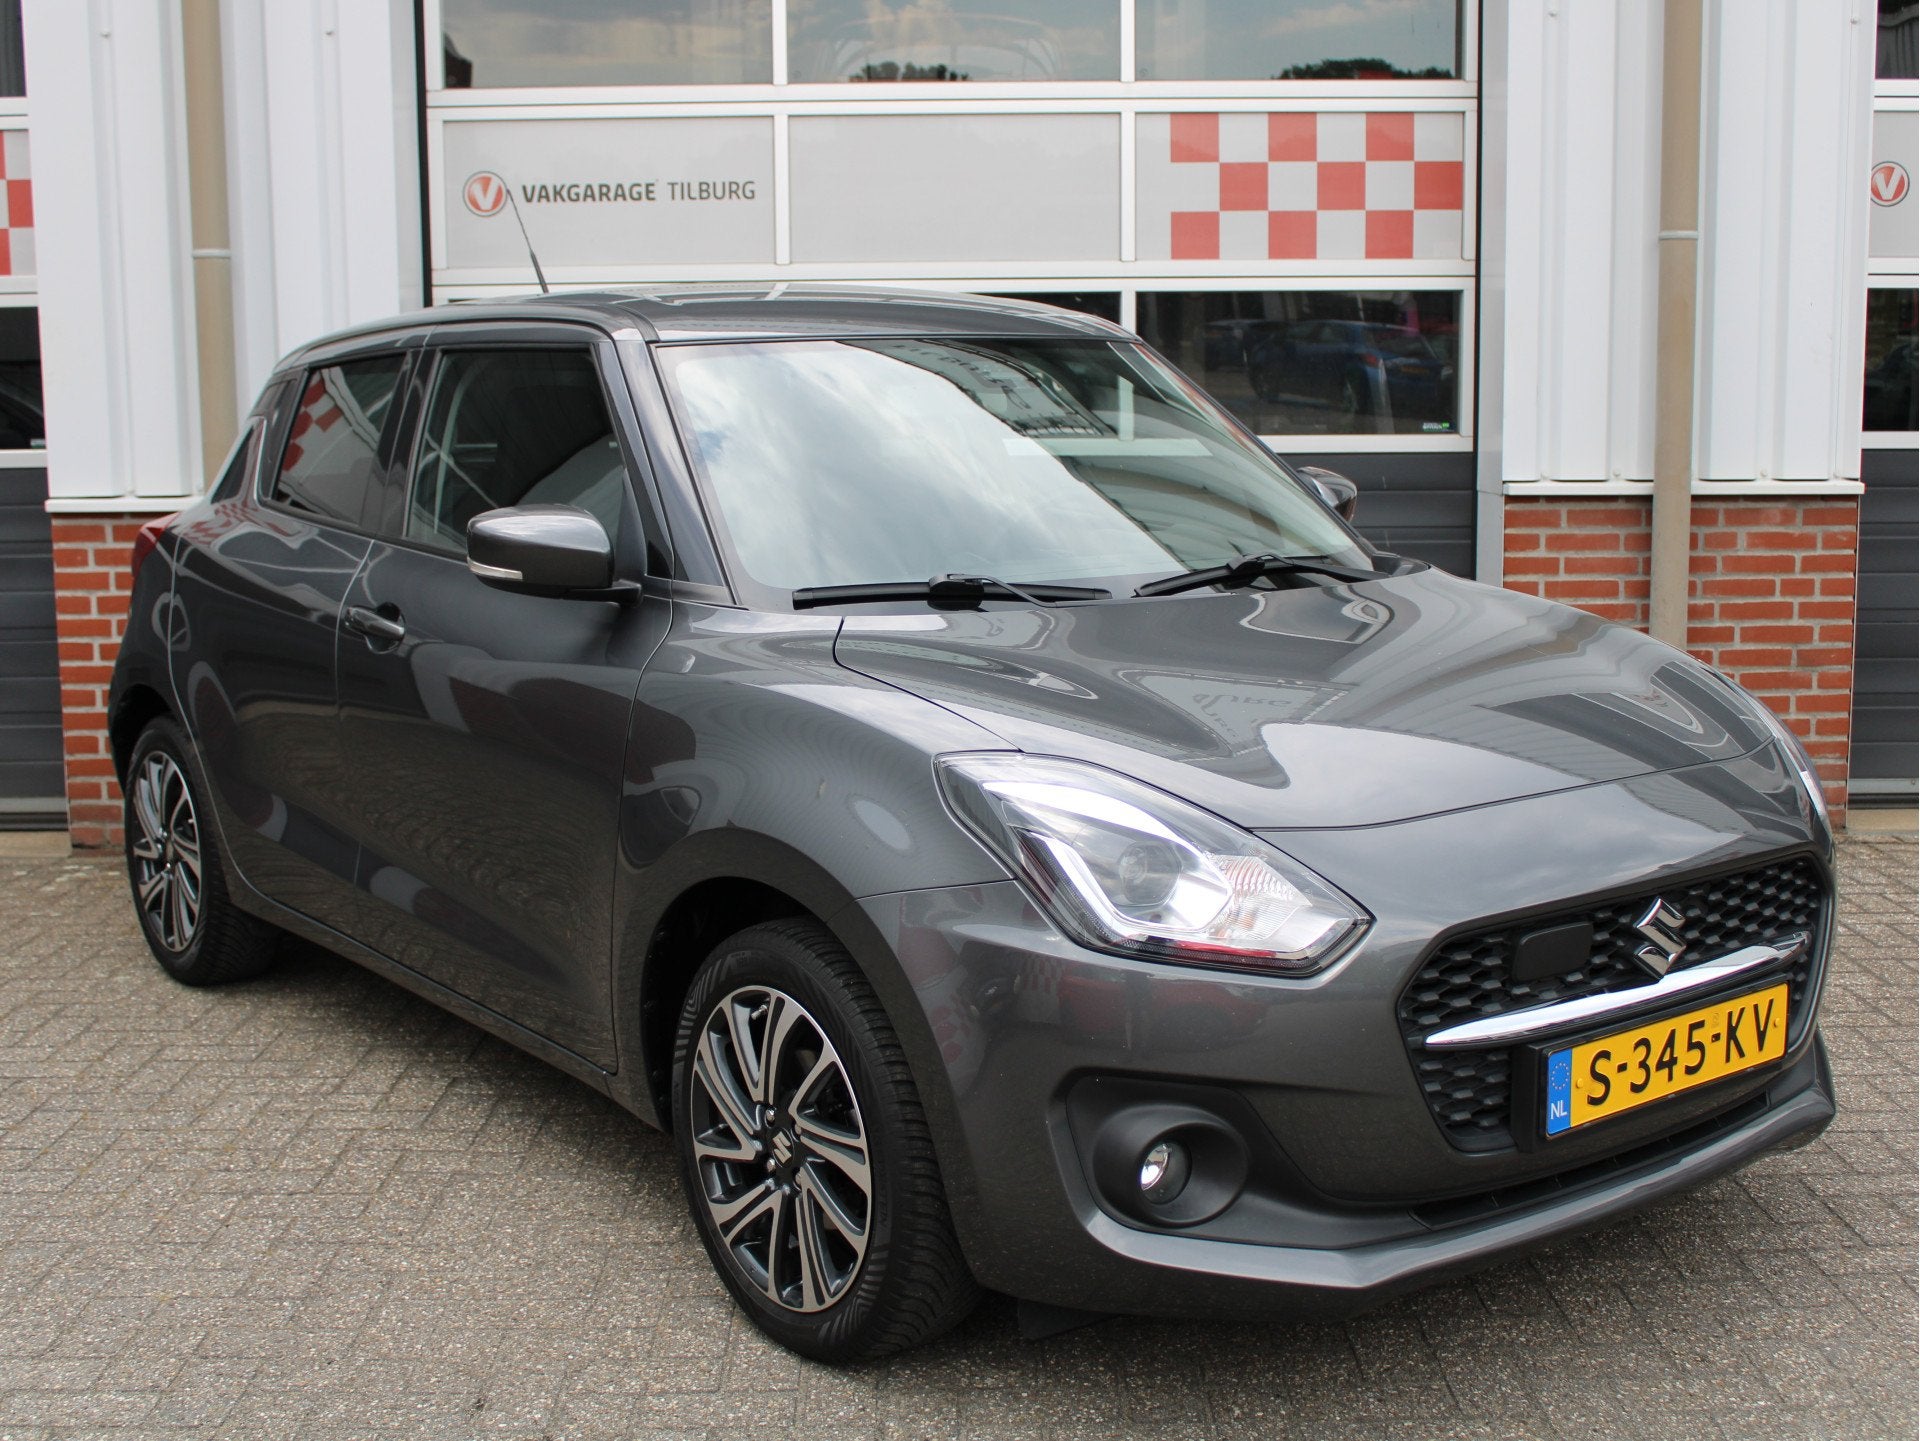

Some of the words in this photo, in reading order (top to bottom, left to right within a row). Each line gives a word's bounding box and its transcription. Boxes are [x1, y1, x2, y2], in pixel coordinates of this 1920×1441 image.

[522, 183, 656, 203] VAKGARAGE
[667, 181, 756, 200] TILBURG
[1586, 998, 1774, 1106] S-345-KV
[1551, 1101, 1568, 1120] NL
